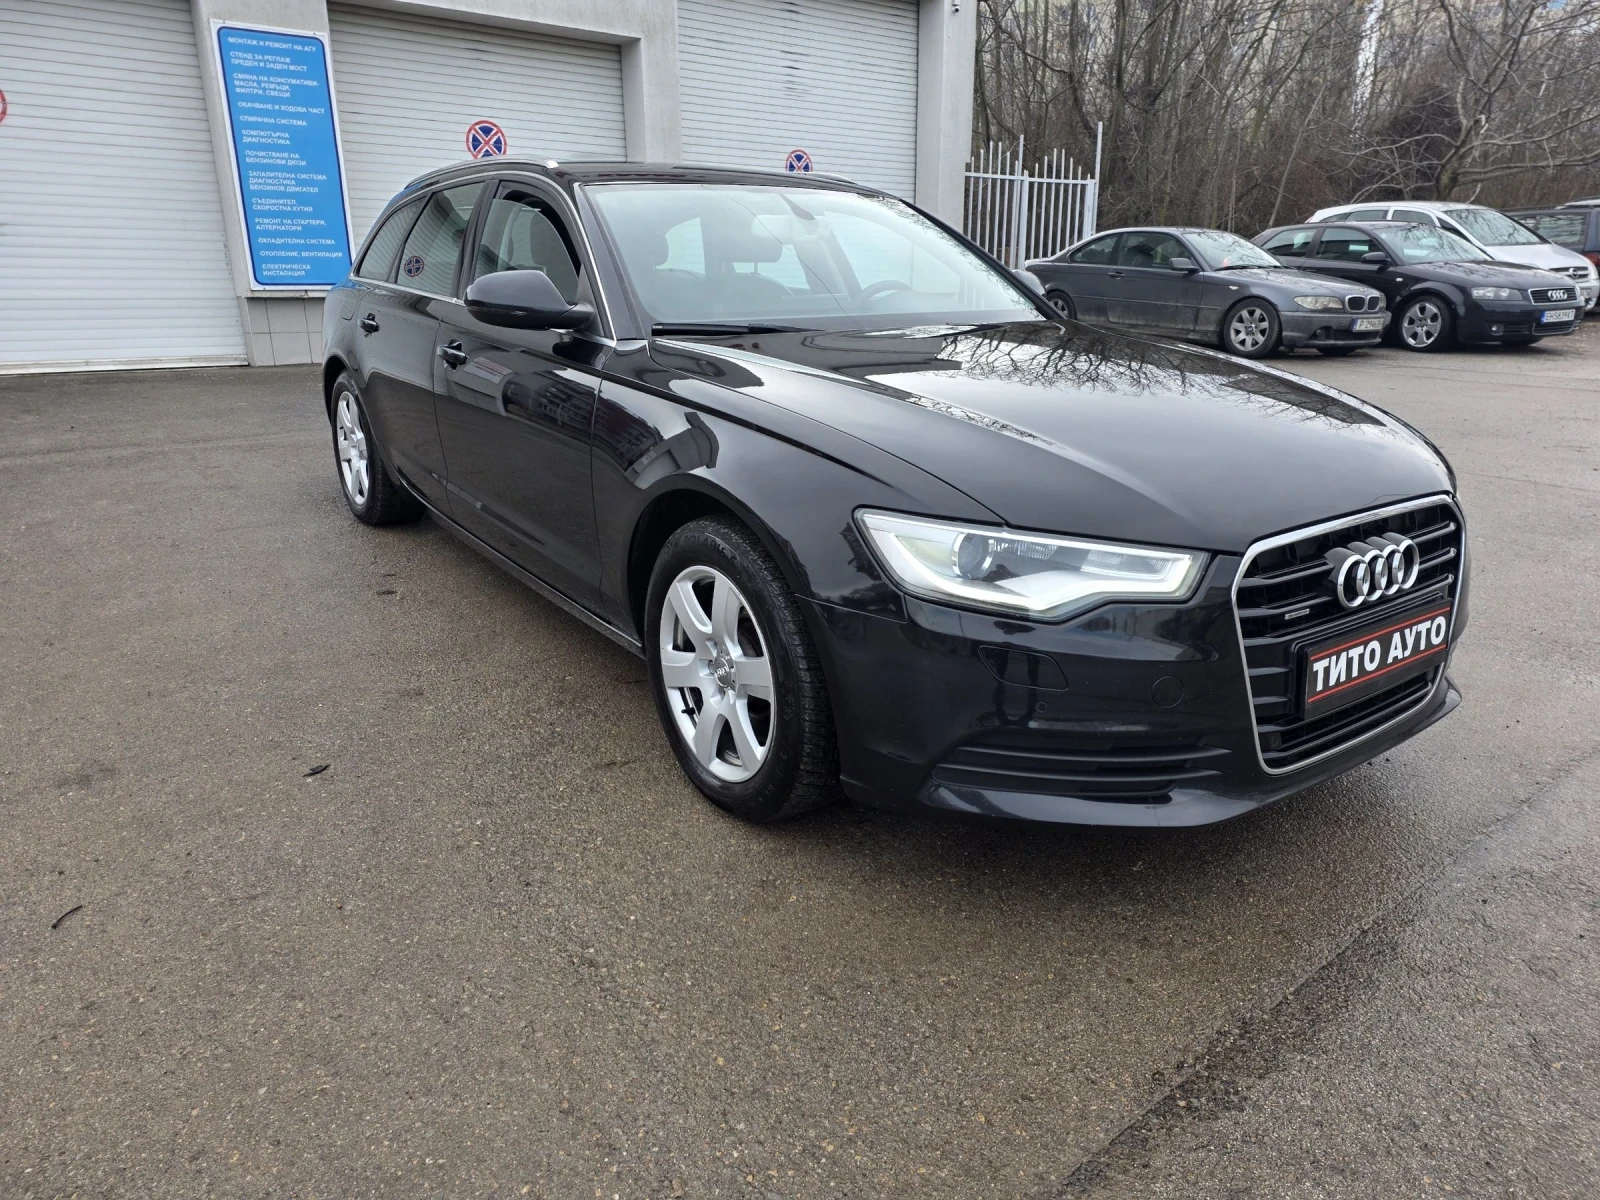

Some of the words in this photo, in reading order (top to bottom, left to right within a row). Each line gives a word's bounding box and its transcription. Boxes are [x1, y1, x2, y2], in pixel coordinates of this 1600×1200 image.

[228, 37, 258, 46] МОНТАЖ
[230, 52, 252, 60] СТЕНД
[231, 59, 258, 67] ПРЕДЕН
[242, 130, 289, 138] КОМПЮТЪРНА
[242, 136, 290, 144] ДИАГНОСТИКА
[1312, 640, 1381, 692] ТИТО
[1387, 616, 1446, 664] АУТО
